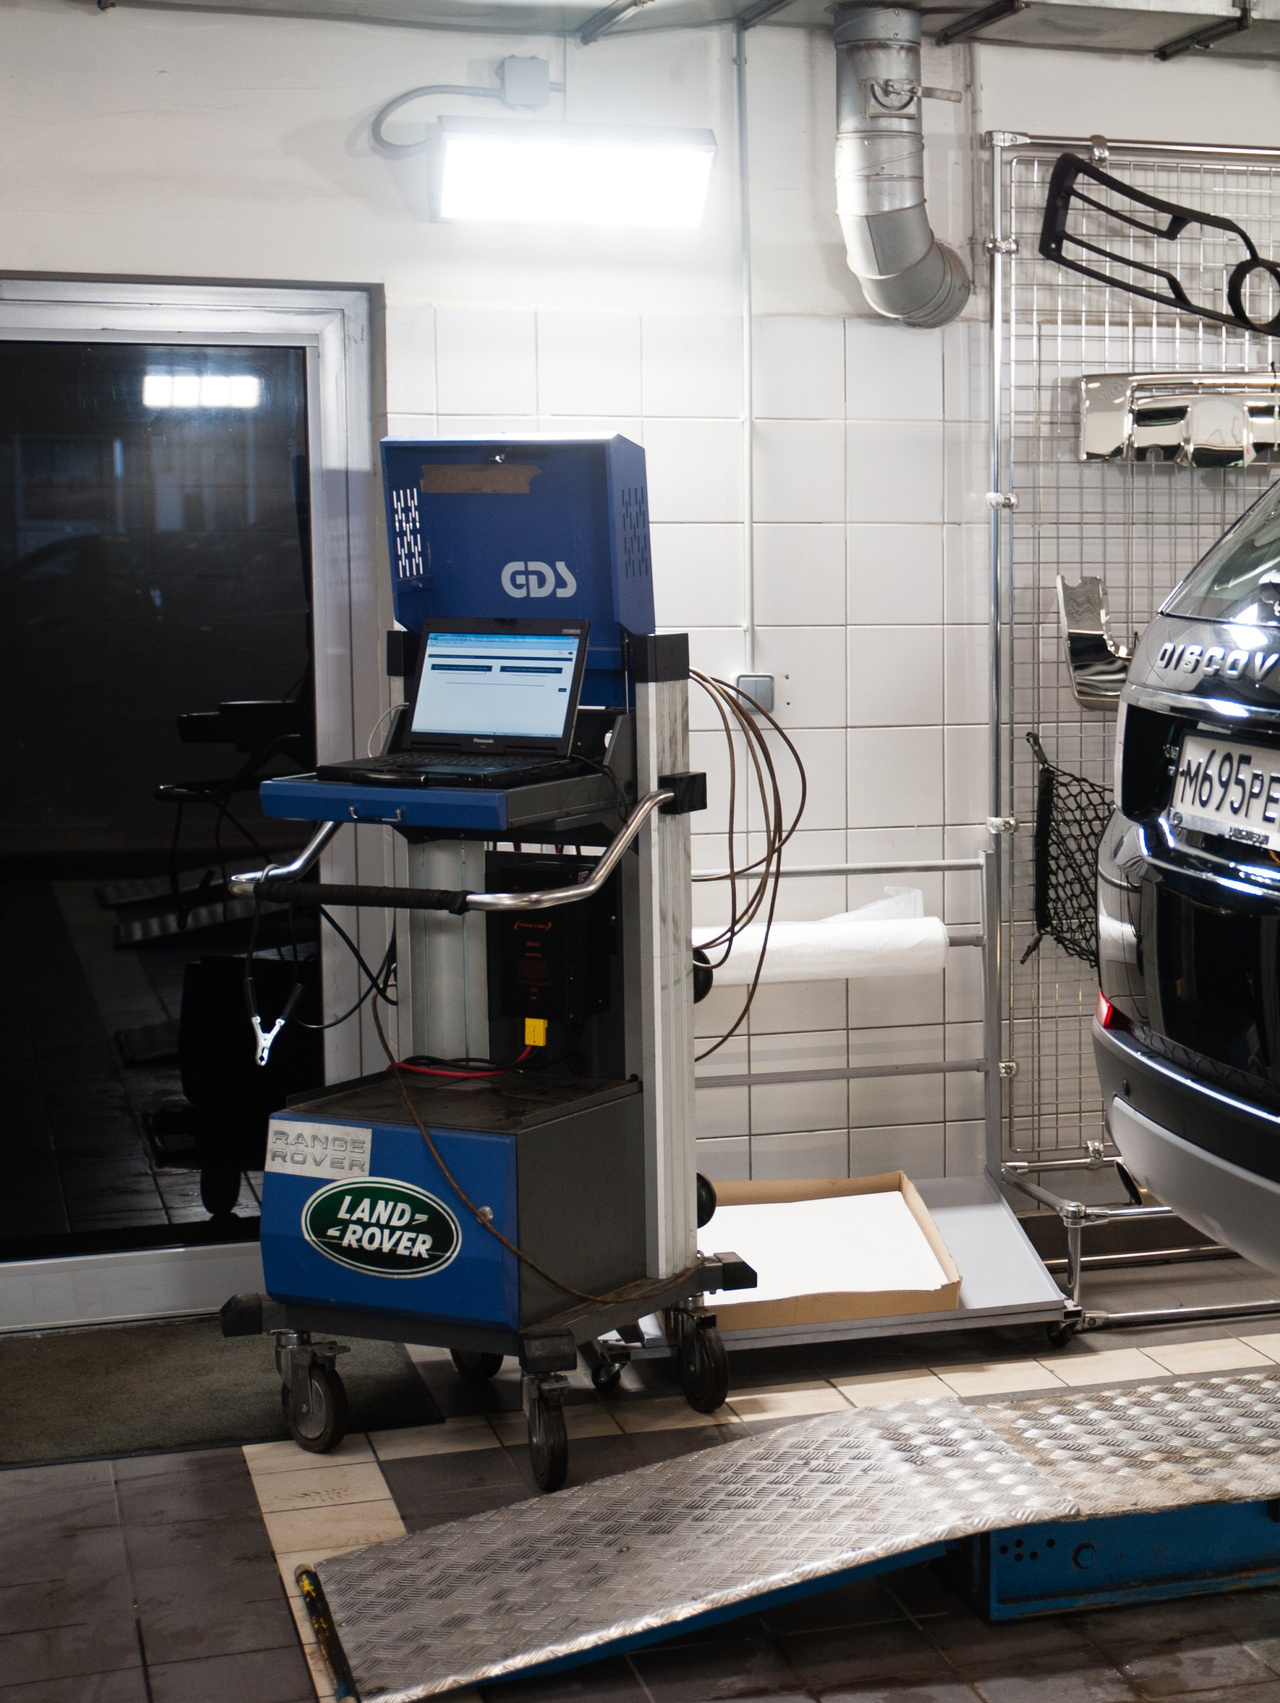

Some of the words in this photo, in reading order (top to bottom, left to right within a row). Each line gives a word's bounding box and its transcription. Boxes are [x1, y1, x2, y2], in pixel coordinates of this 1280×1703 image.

[501, 561, 577, 598] GDS
[272, 1130, 366, 1155] RANGE
[271, 1150, 366, 1173] ROVER
[337, 1195, 412, 1227] LAND
[341, 1224, 433, 1259] ROVER
